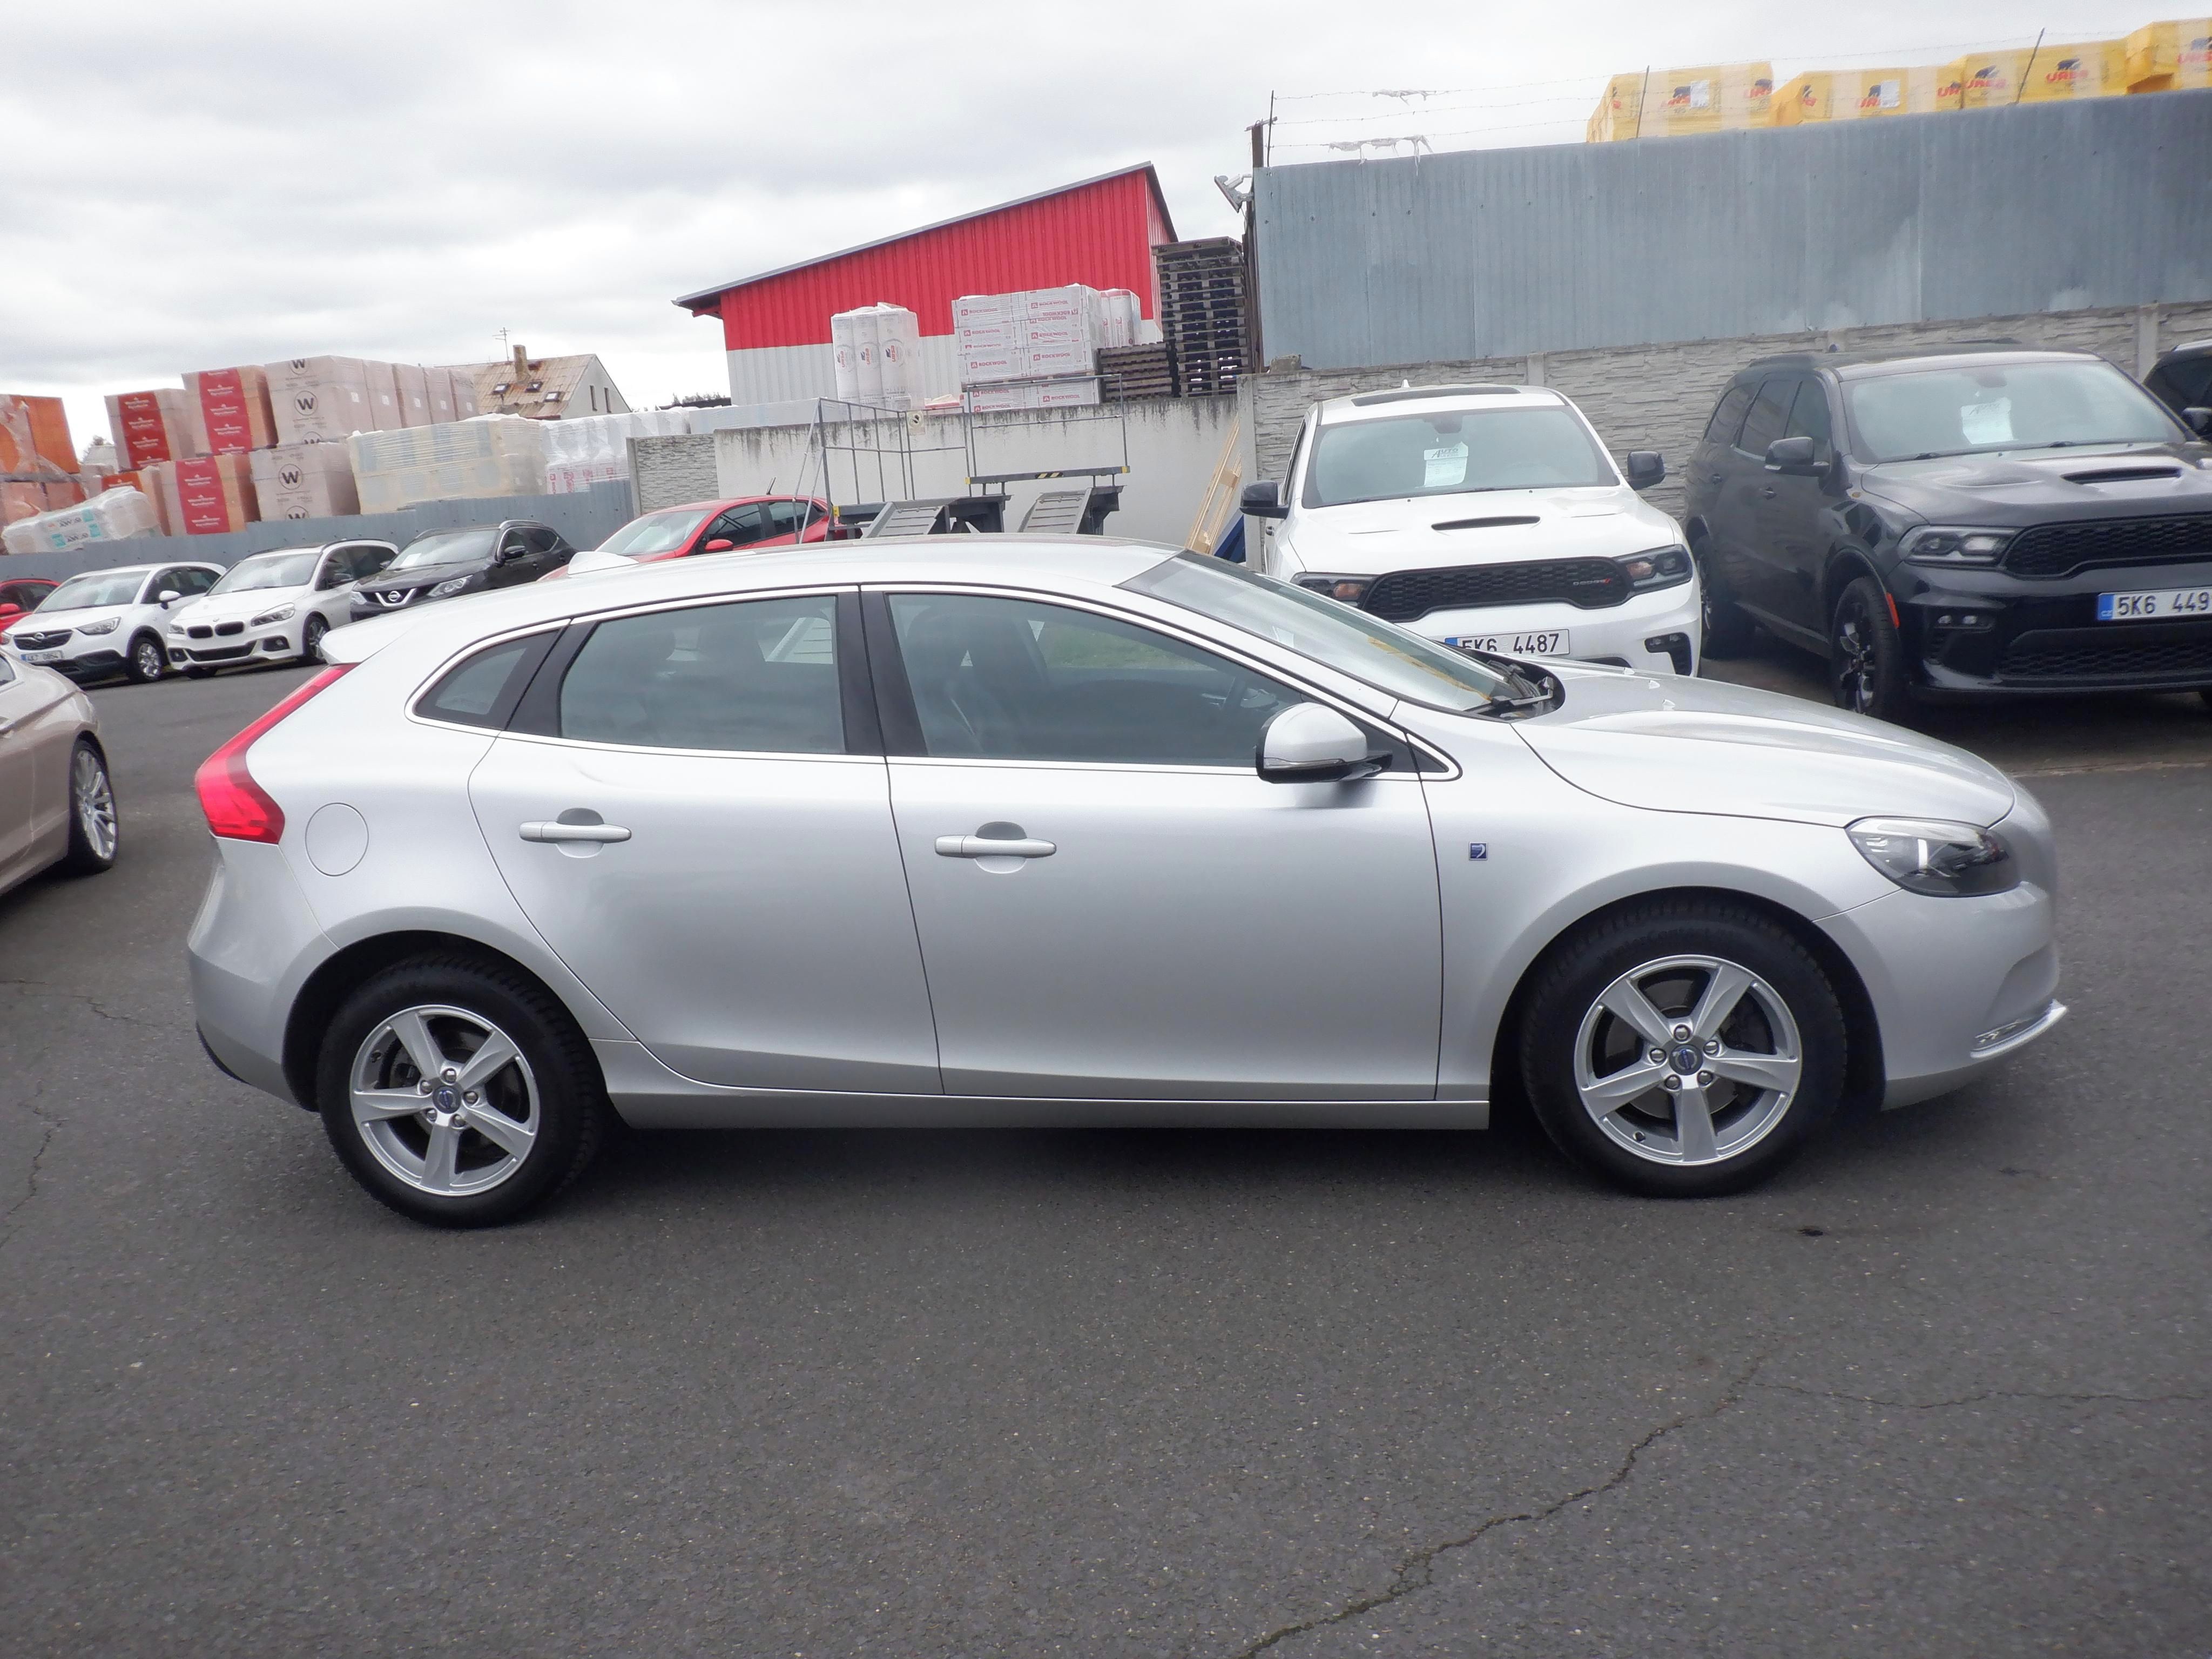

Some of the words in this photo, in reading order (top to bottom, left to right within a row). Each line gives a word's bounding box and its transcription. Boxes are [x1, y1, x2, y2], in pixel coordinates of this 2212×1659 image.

[297, 397, 314, 410] W
[281, 471, 299, 484] W
[2117, 595, 2157, 616] 5K6
[2171, 591, 2212, 613] 449
[1513, 633, 1560, 655] 4487
